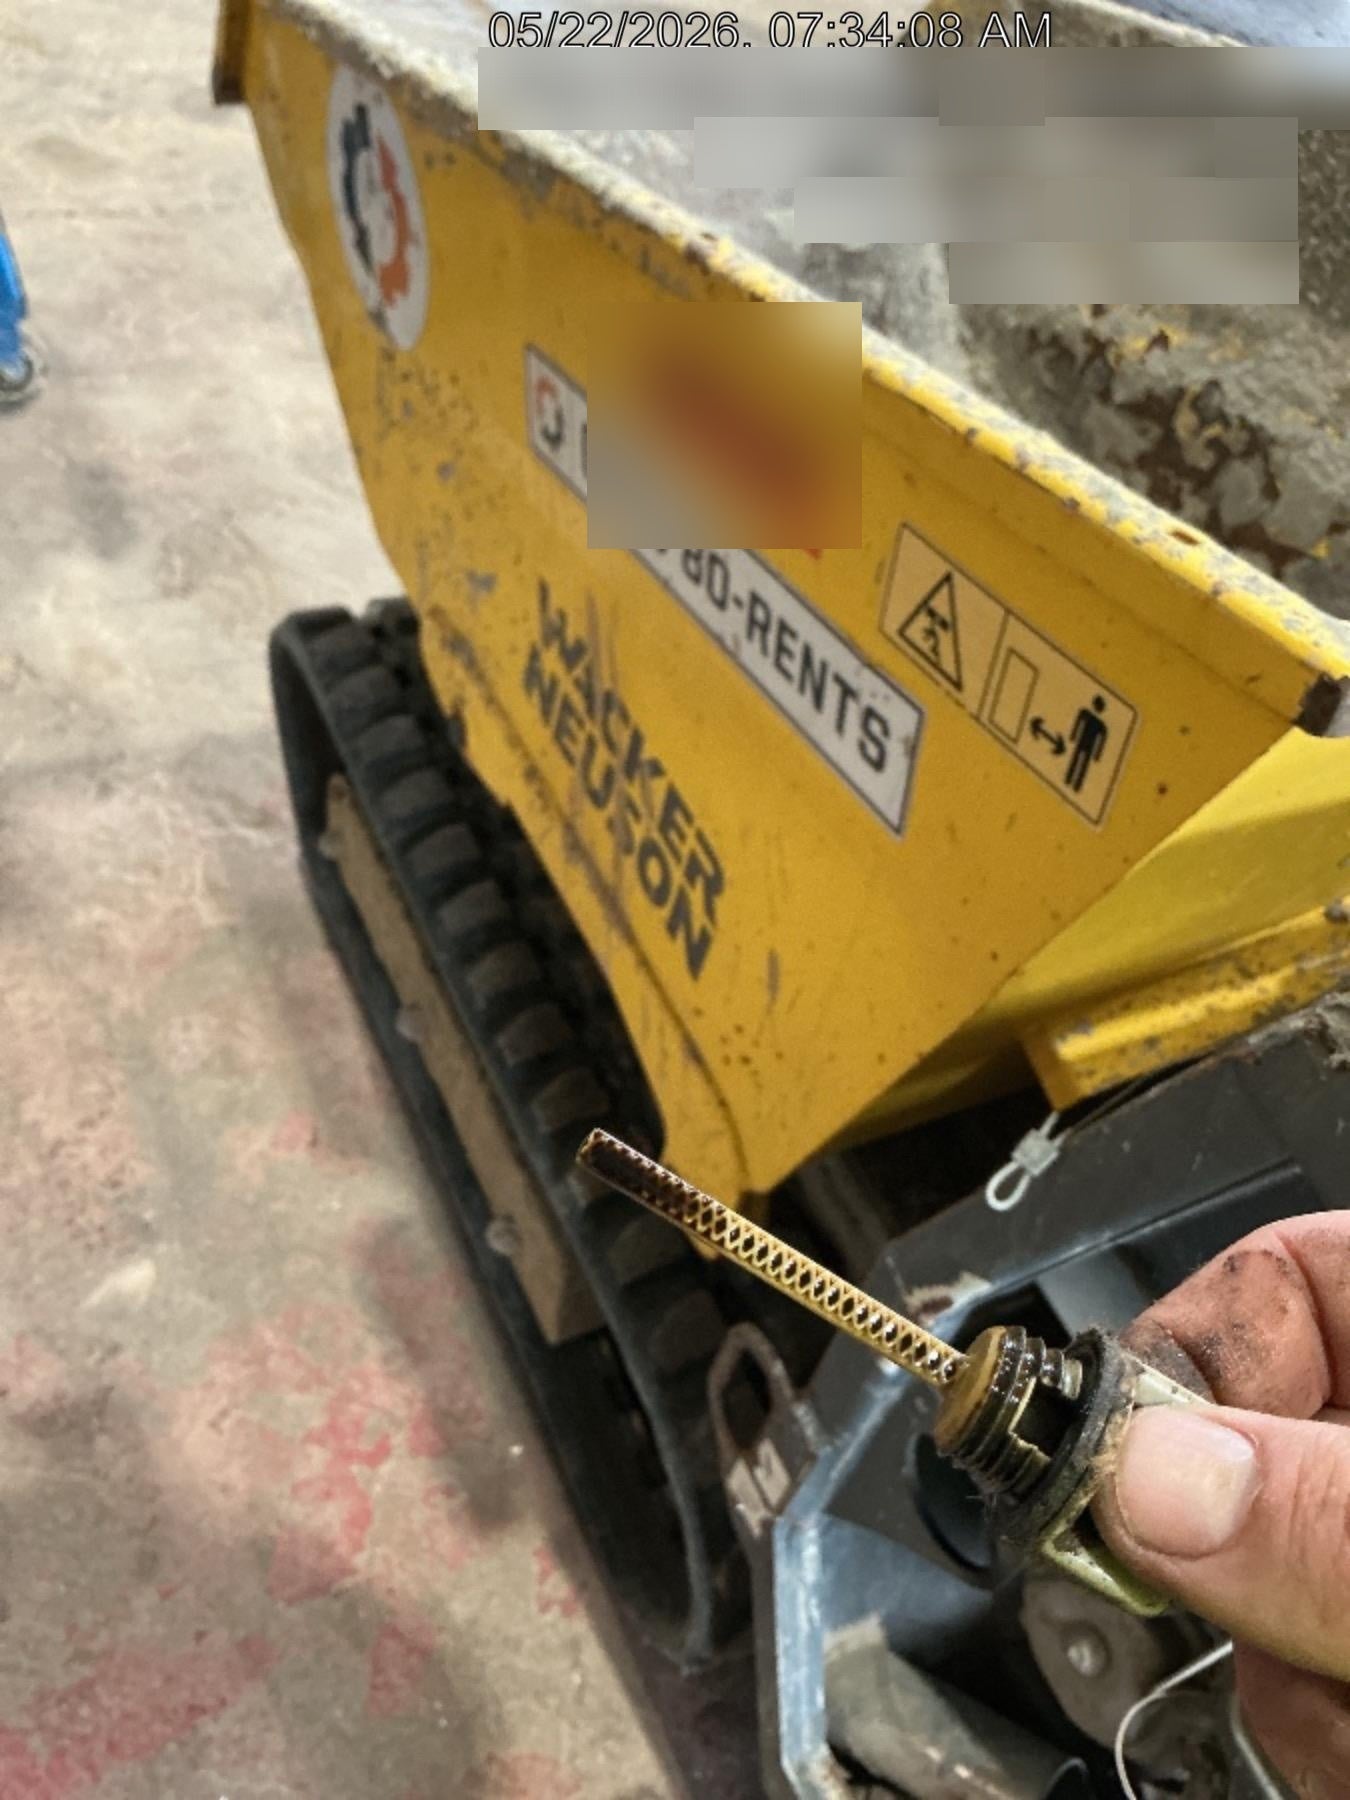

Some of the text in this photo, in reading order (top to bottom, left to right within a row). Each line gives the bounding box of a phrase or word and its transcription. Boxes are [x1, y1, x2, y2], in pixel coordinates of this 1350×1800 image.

[522, 642, 713, 982] NEUSON
[538, 576, 725, 928] WACKER
[655, 549, 891, 773] 80-RENTS
